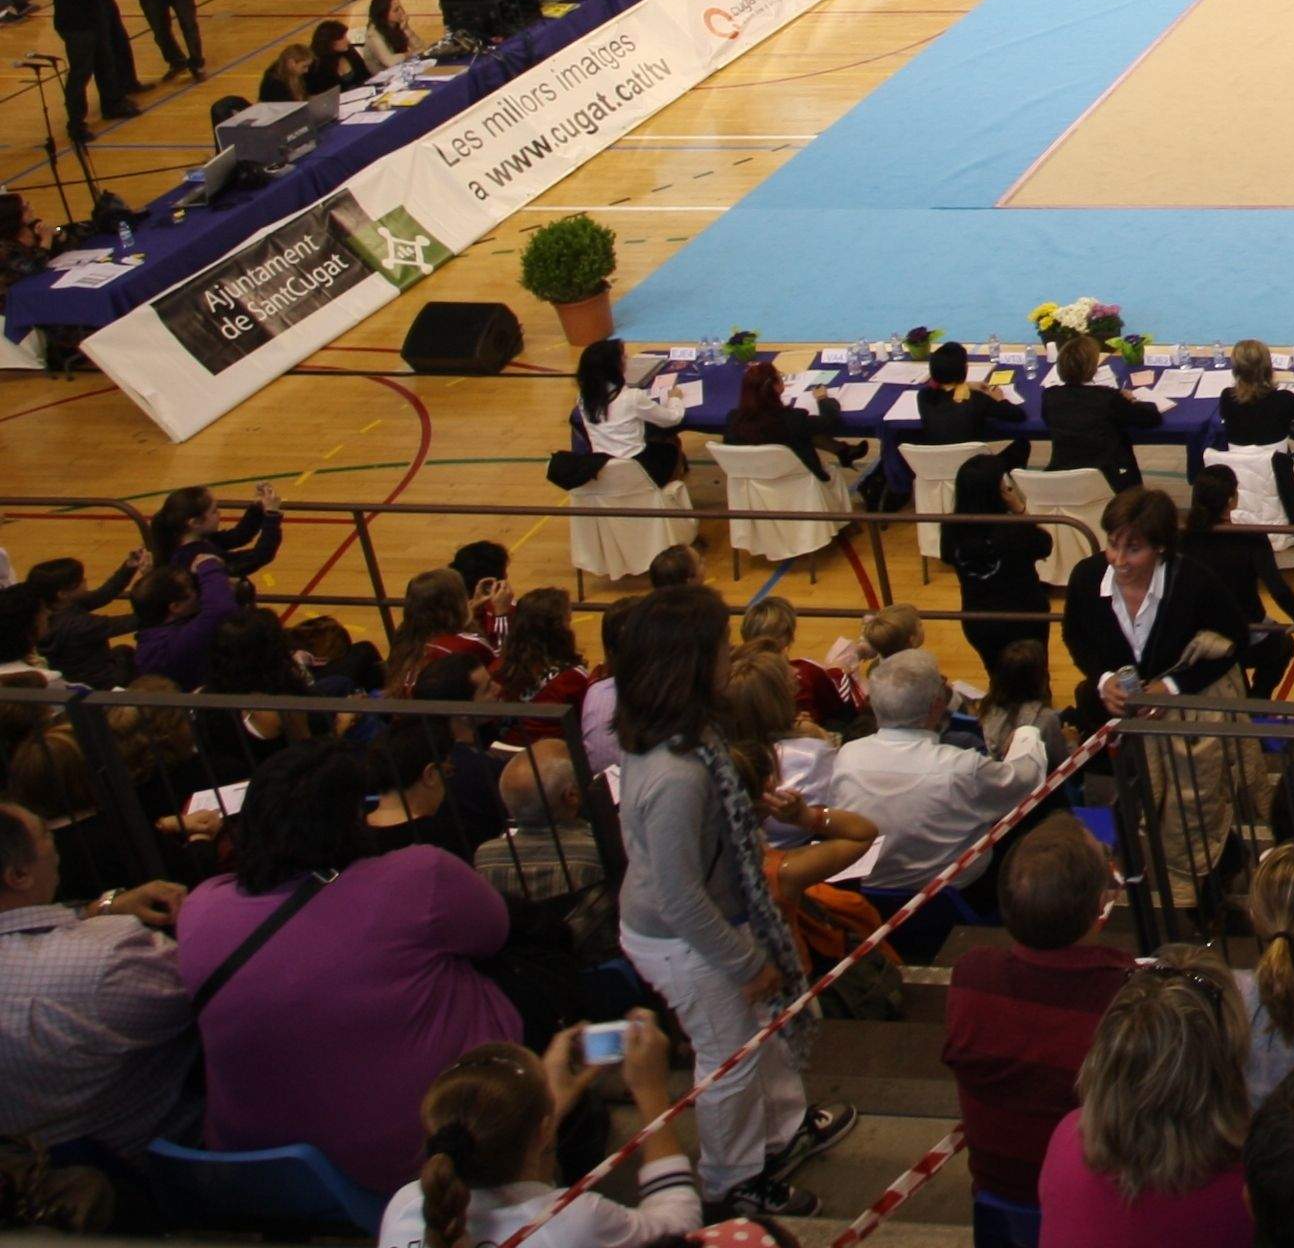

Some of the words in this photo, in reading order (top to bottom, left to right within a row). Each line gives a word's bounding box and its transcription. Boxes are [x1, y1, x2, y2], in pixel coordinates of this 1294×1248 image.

[433, 128, 483, 167] Les
[481, 83, 557, 138] millors
[551, 33, 636, 92] imatges
[468, 180, 490, 201] a
[485, 56, 673, 187] www.cugat.cat/tv
[205, 234, 320, 313] Ajuntament
[221, 315, 253, 340] de
[247, 254, 349, 321] SantCugat
